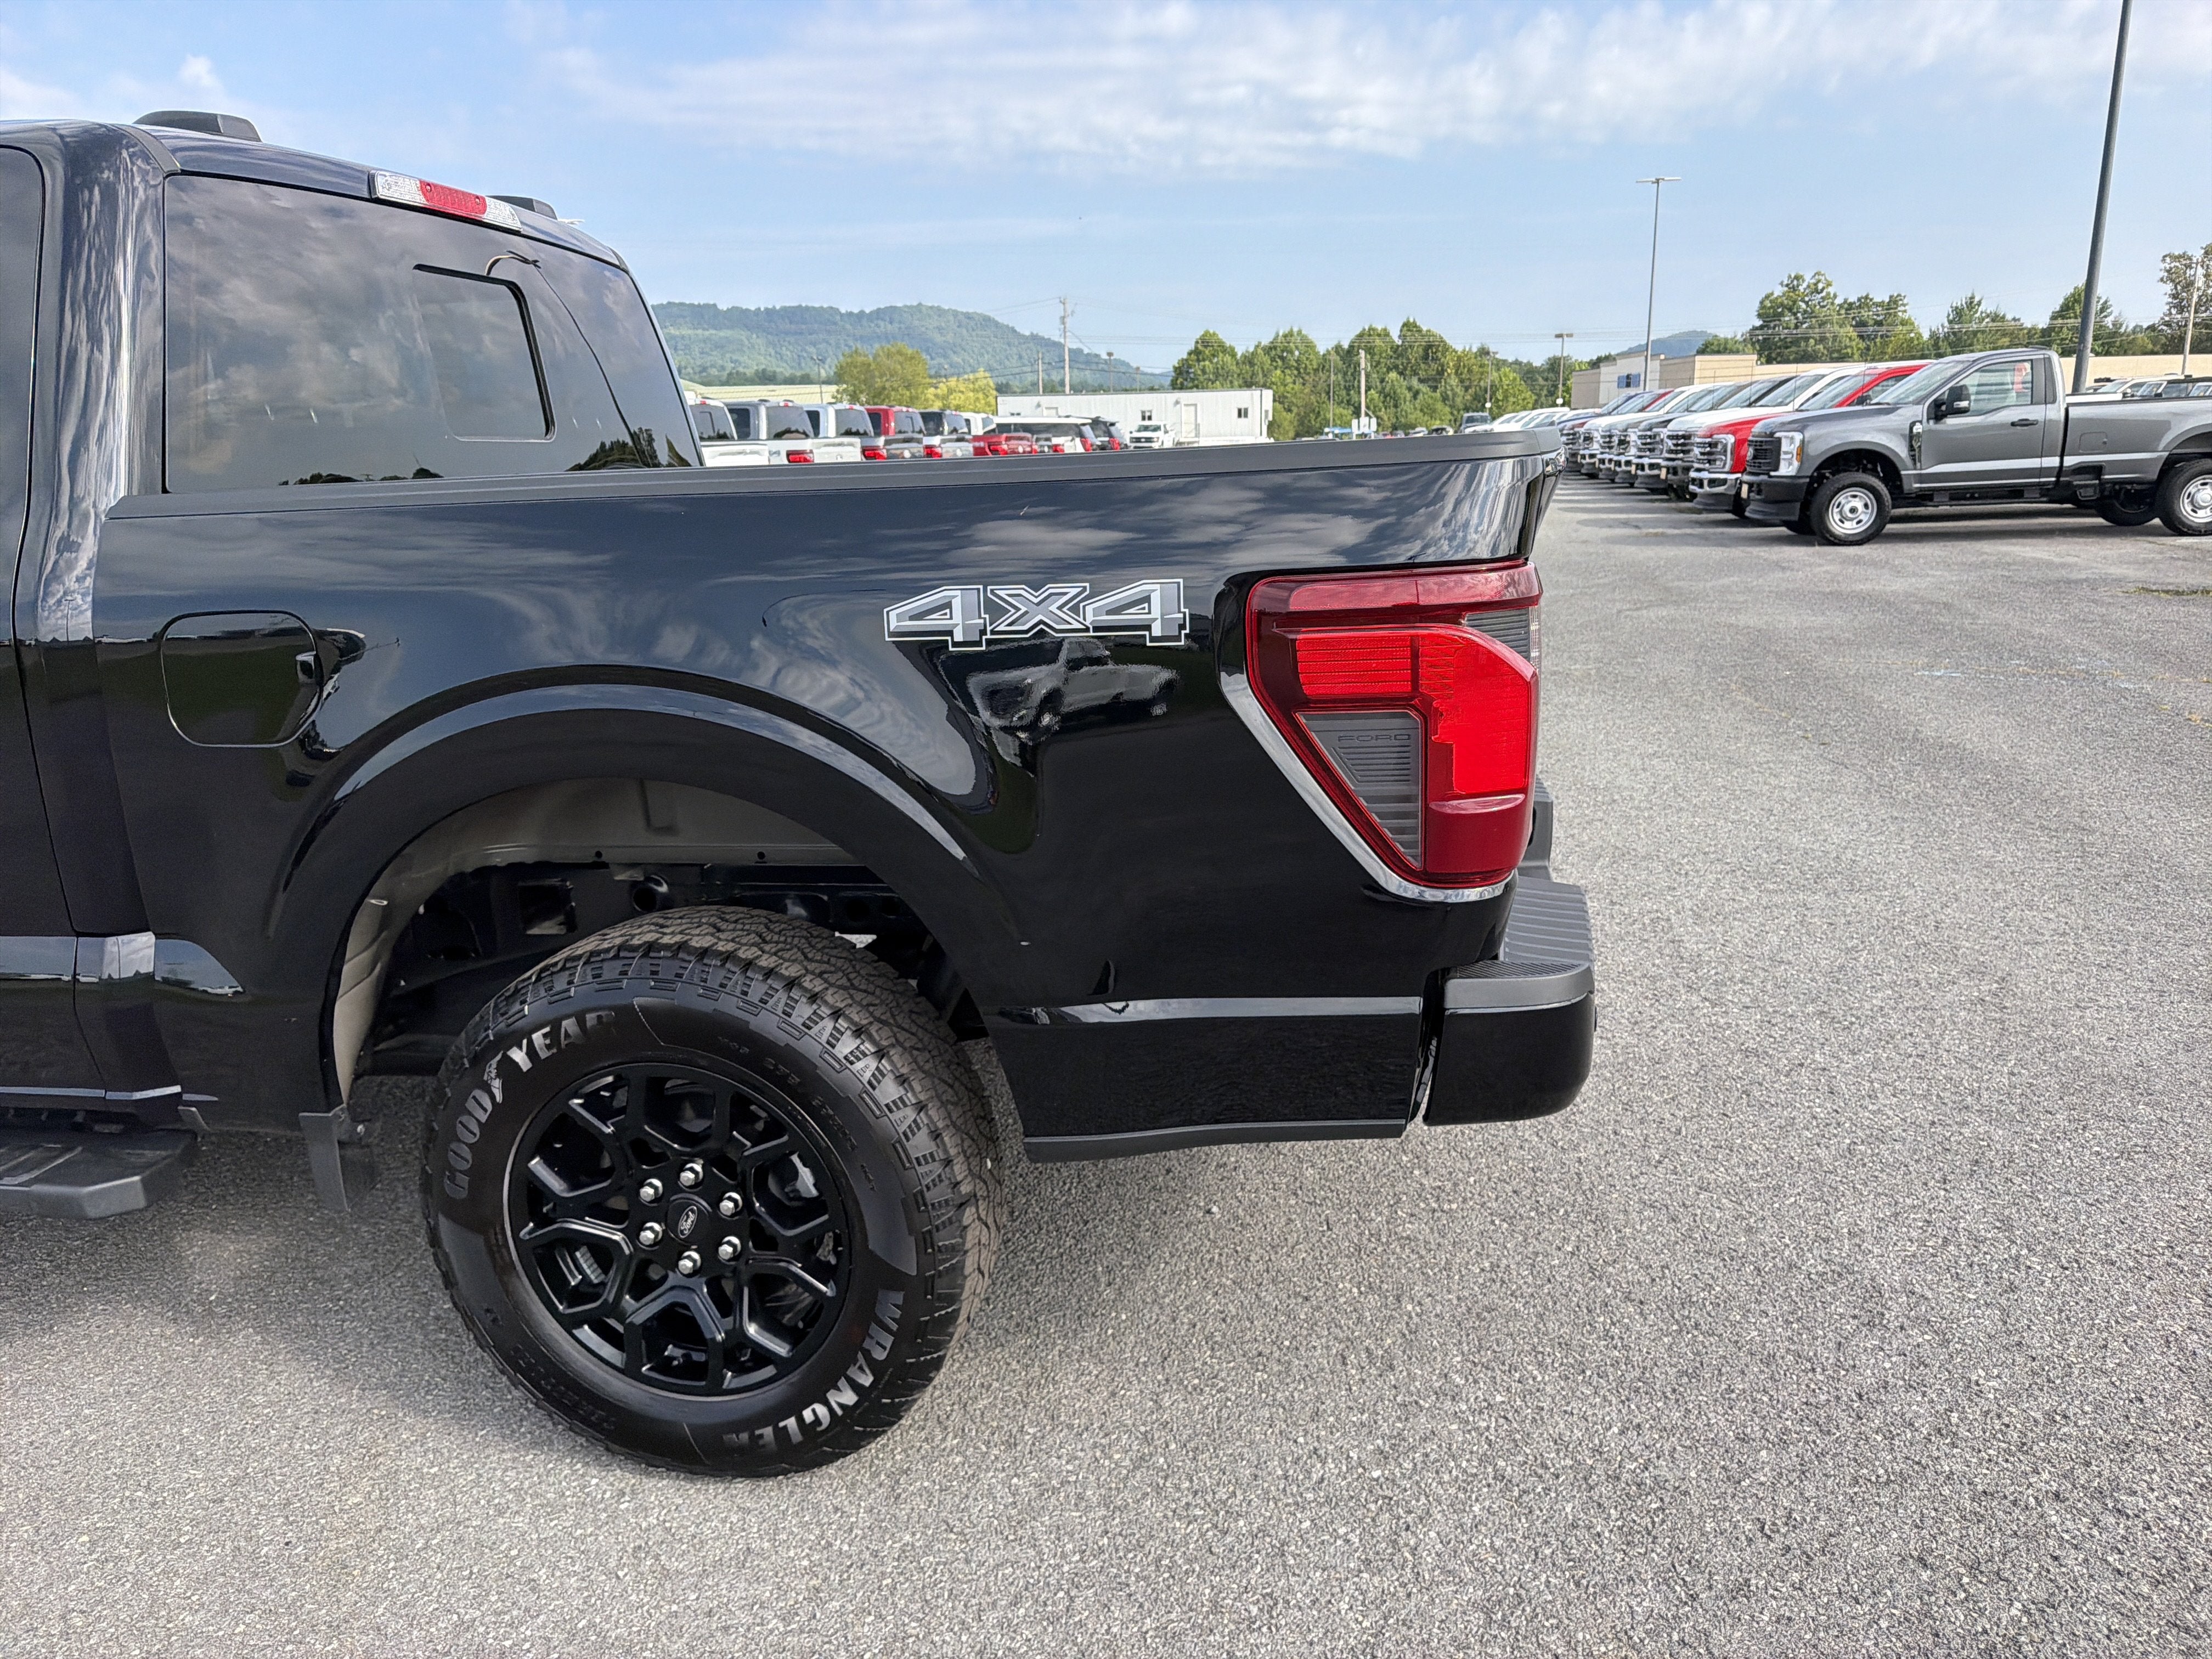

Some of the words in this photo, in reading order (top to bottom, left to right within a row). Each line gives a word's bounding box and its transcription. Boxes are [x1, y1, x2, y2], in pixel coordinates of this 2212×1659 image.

[1338, 733, 1412, 742] FORD
[680, 1209, 696, 1235] Ford
[721, 1289, 905, 1452] WRANGLER
